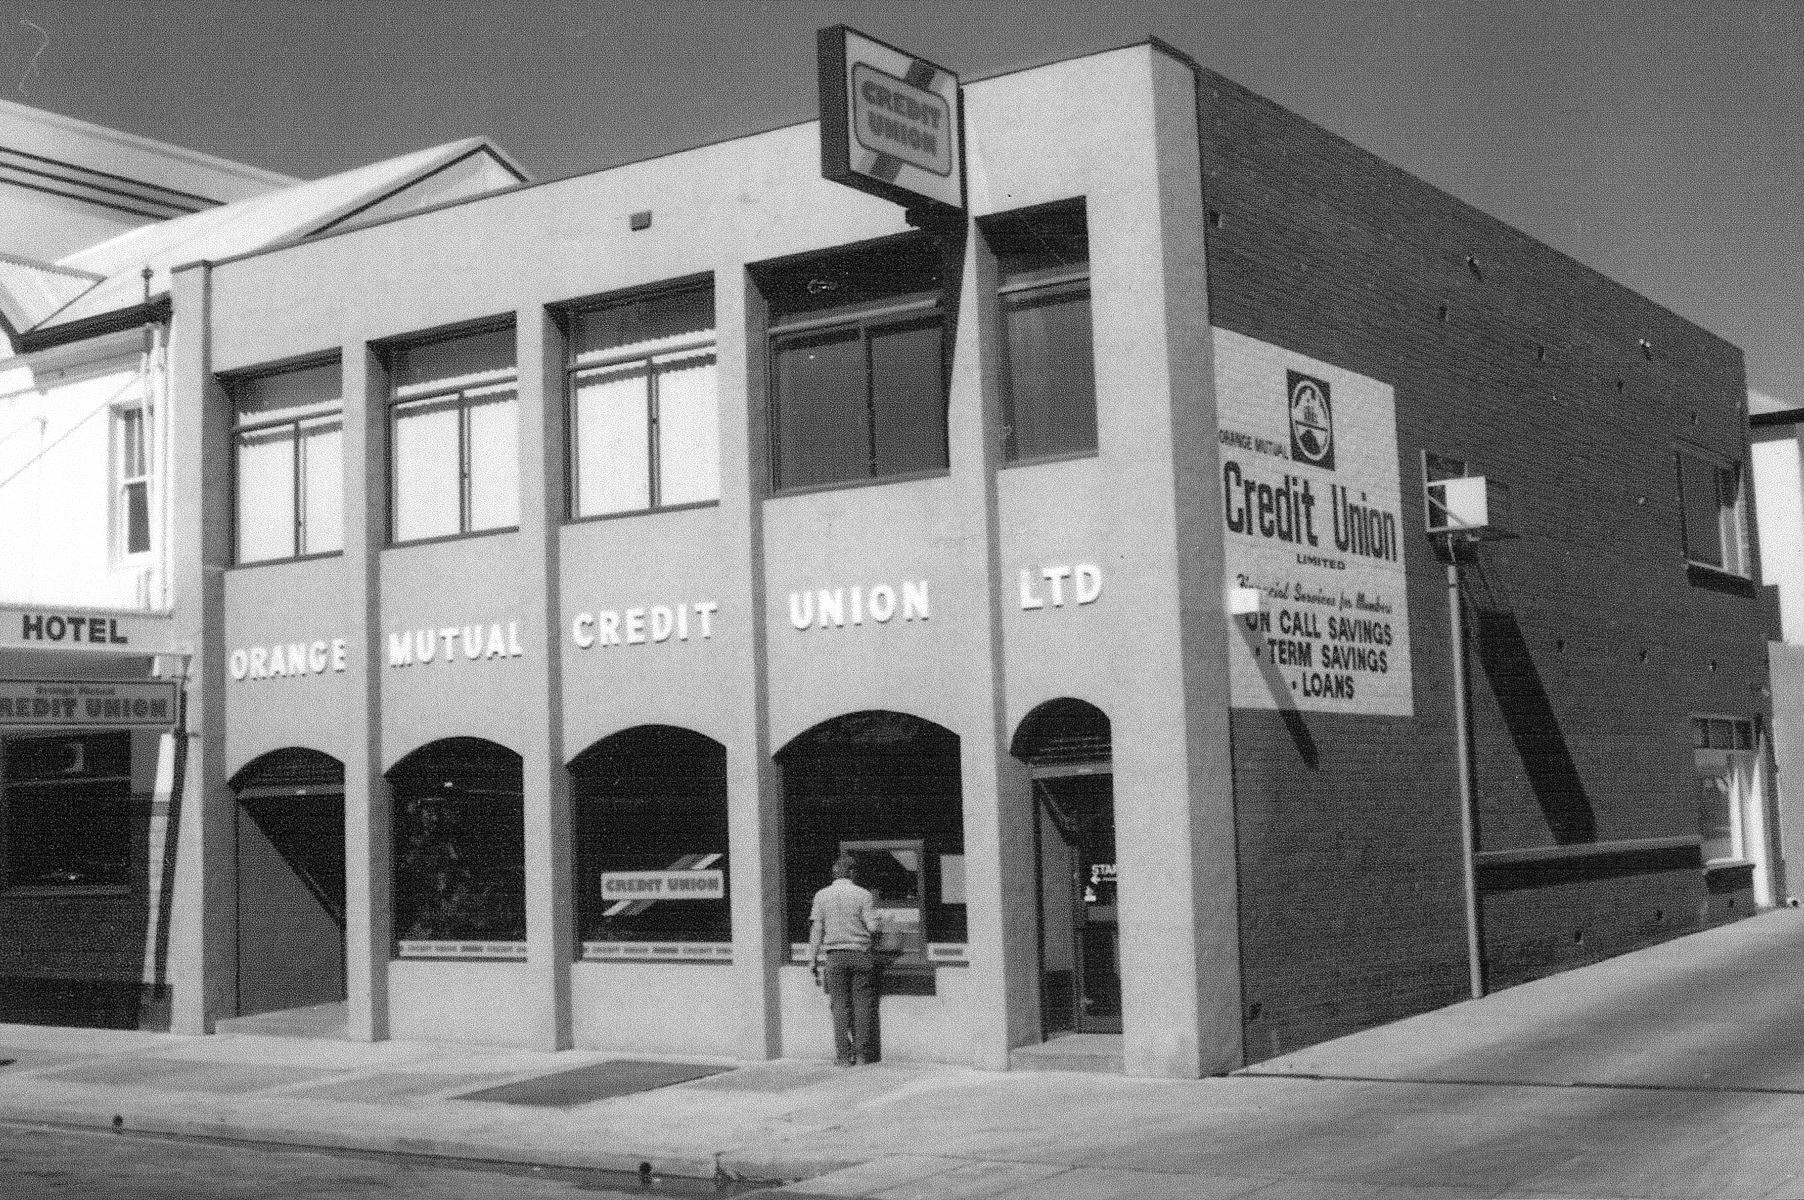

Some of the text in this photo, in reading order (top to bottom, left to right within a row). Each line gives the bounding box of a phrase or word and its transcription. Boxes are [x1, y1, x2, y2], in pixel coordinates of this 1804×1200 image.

[861, 80, 941, 130] CREDIT
[868, 111, 937, 158] UNION
[1223, 460, 1397, 562] Credit Union
[1296, 553, 1346, 570] LIMITED
[1294, 582, 1336, 606] Services
[1355, 592, 1393, 614] Members
[22, 615, 128, 644] HOTEL
[229, 563, 1102, 680] ORANGE MUTUAL CREDIT UNION LTD
[1245, 609, 1393, 647] ON CALL SAVINGS
[1267, 637, 1388, 673] TERM SAVINGS
[1302, 671, 1354, 699] LOANS
[85, 698, 168, 718] UNION
[605, 877, 719, 892] CREDIT UNION
